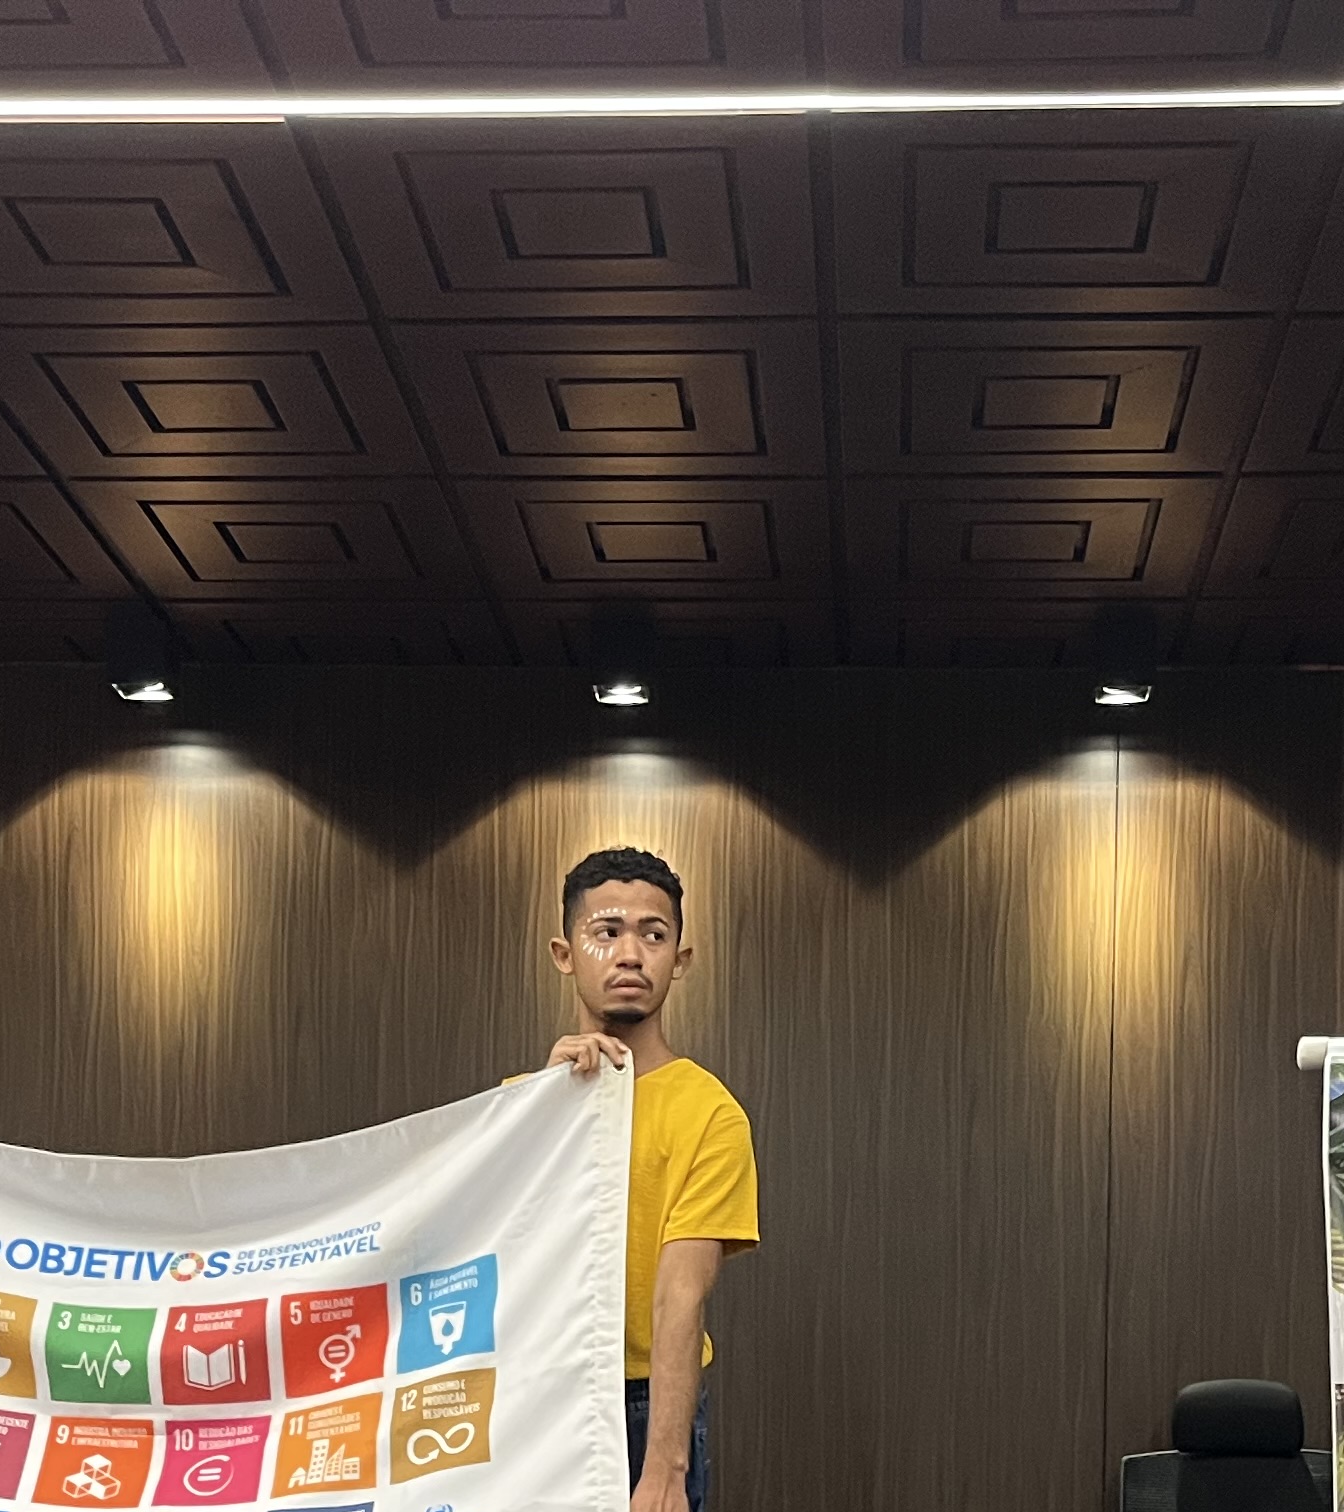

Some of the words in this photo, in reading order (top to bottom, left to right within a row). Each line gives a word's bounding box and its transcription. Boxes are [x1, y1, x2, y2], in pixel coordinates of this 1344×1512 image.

[5, 1238, 230, 1282] OBJETIVOS
[409, 1282, 423, 1306] 6
[57, 1310, 72, 1330] 3
[174, 1312, 187, 1333] 4
[289, 1301, 303, 1325] 5
[400, 1389, 418, 1412] 12
[55, 1424, 70, 1444] 9
[289, 1415, 304, 1436] 11
[172, 1428, 194, 1451] 10
